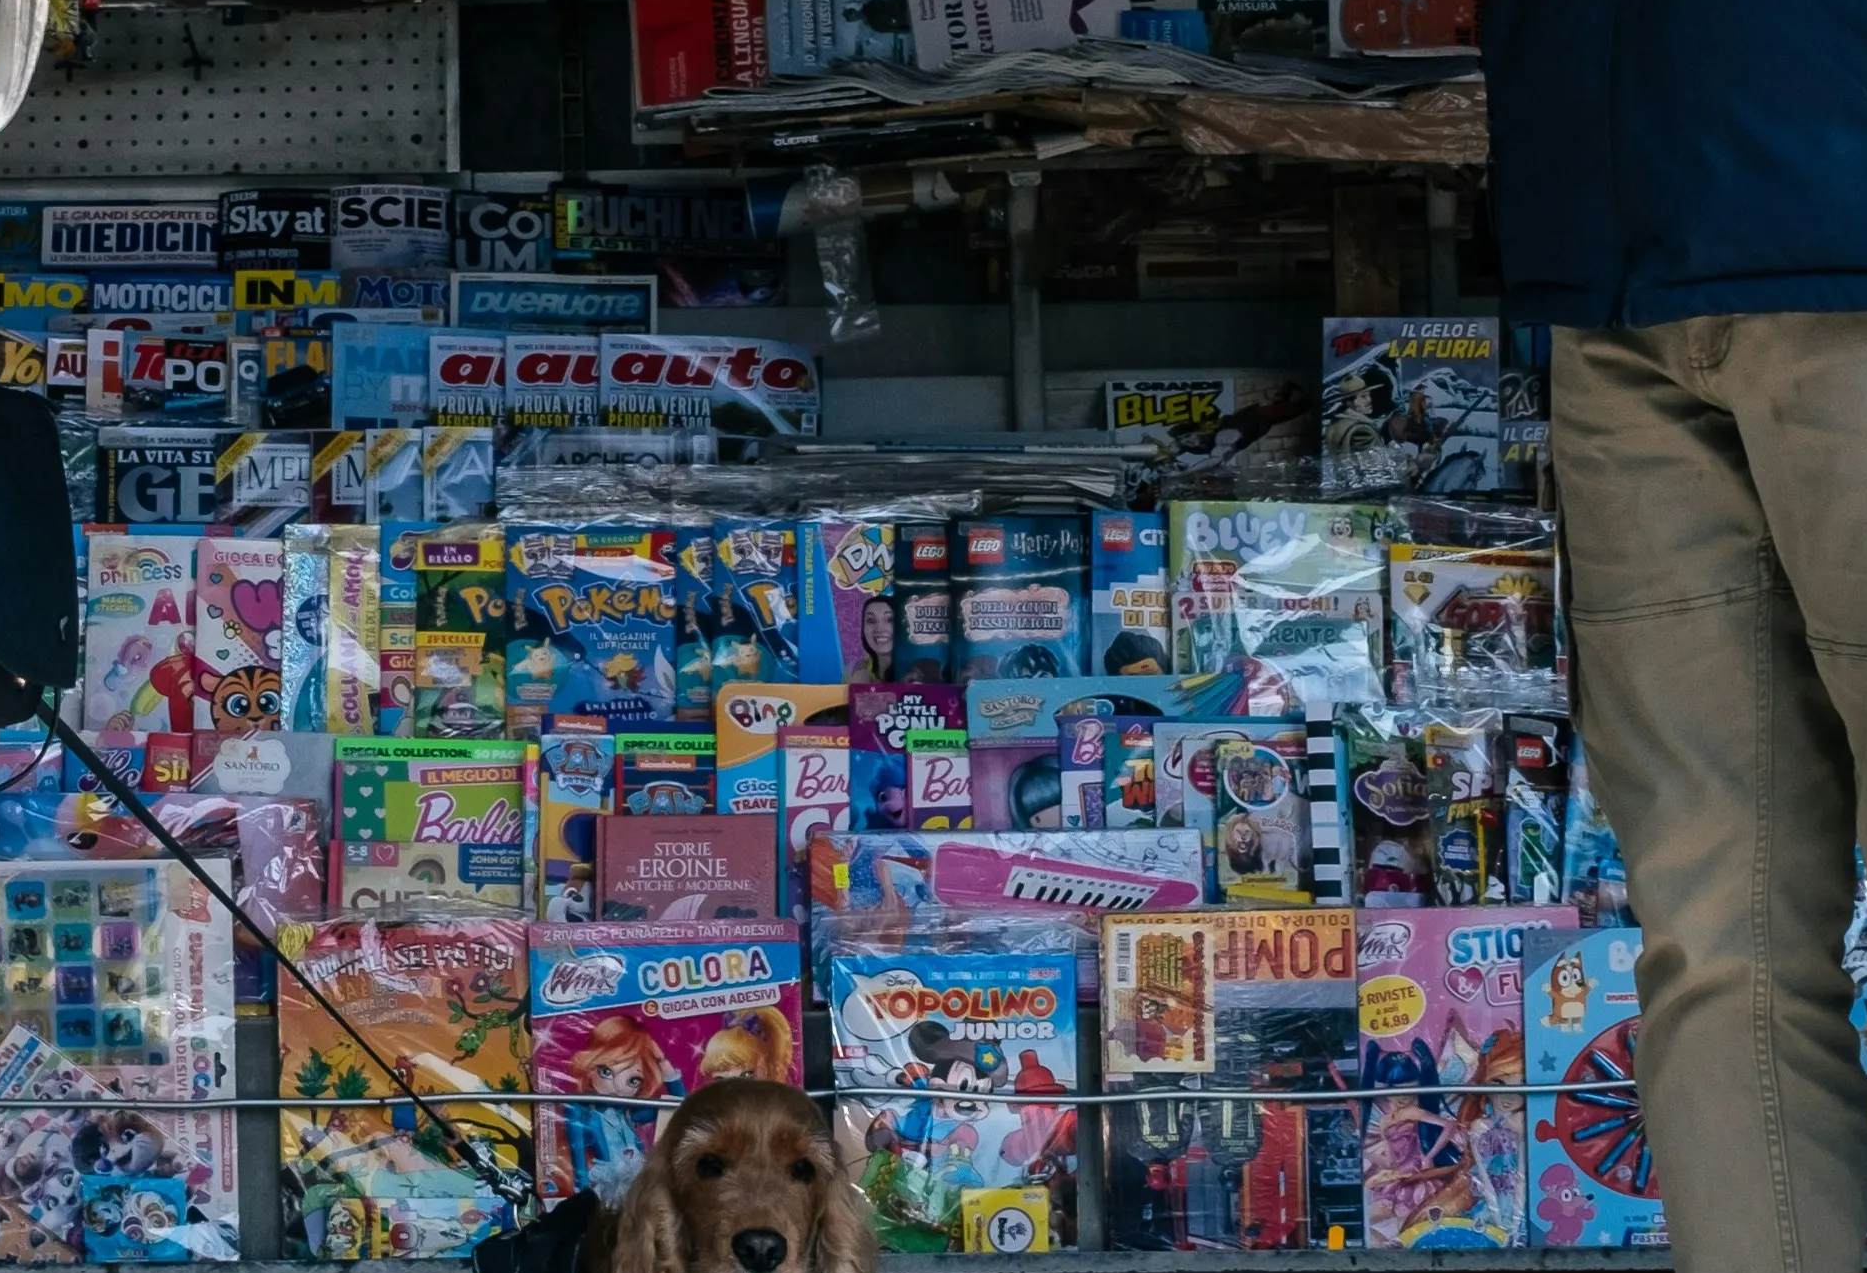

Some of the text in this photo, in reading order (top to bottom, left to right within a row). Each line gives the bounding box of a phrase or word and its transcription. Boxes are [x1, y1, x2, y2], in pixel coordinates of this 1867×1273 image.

[230, 206, 326, 238] Sky at
[1389, 336, 1492, 360] LA FURIA
[611, 346, 811, 391] auto
[608, 394, 711, 417] PROVA VERITA
[1115, 388, 1223, 427] BLEK
[969, 537, 1001, 555] LEGO
[1103, 527, 1131, 545] LEGO
[1187, 510, 1308, 562] BLUEY
[914, 543, 945, 559] LEGO
[589, 631, 657, 643] IL MAGAZINE
[597, 639, 651, 651] UFFICIALE
[223, 758, 281, 772] SANTORO
[654, 842, 713, 857] STORIE
[639, 859, 728, 878] EROINE
[638, 947, 771, 993] COLORA
[662, 989, 777, 1013] GIOCA CON ADESIVI
[869, 988, 1055, 1021] TOPOLINO
[1366, 986, 1417, 1005] RIVISTE
[949, 1020, 1055, 1041] JUNIOR
